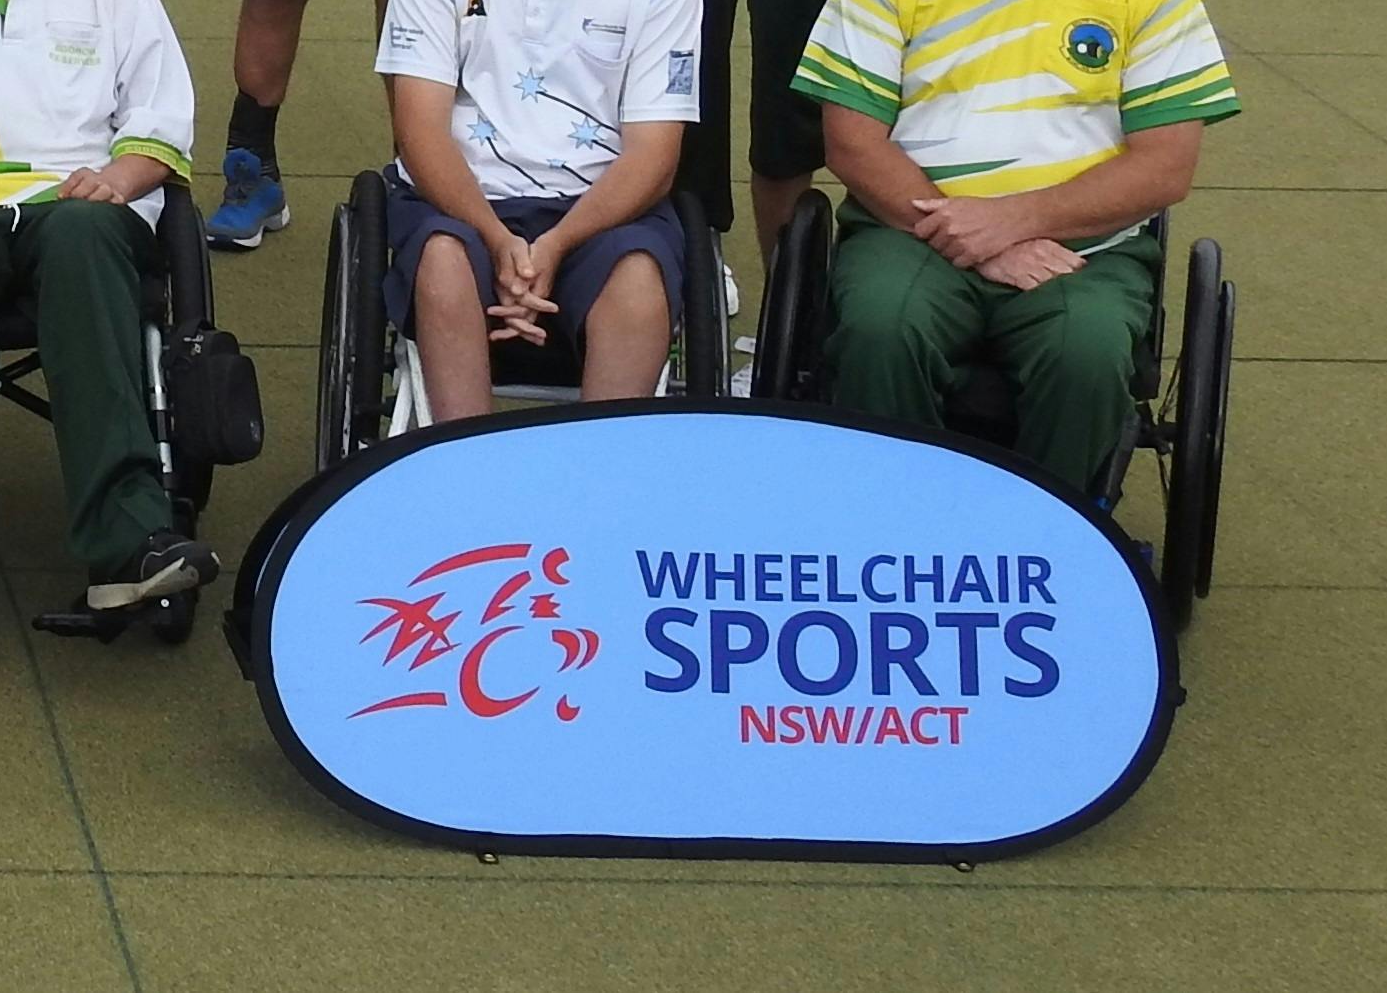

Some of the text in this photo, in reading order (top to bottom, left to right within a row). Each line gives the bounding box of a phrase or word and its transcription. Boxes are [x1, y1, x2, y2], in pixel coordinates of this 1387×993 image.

[635, 550, 1057, 604] WHEELCHAIR
[644, 607, 1061, 698] SPORTS
[740, 704, 969, 745] NSW/ACT
